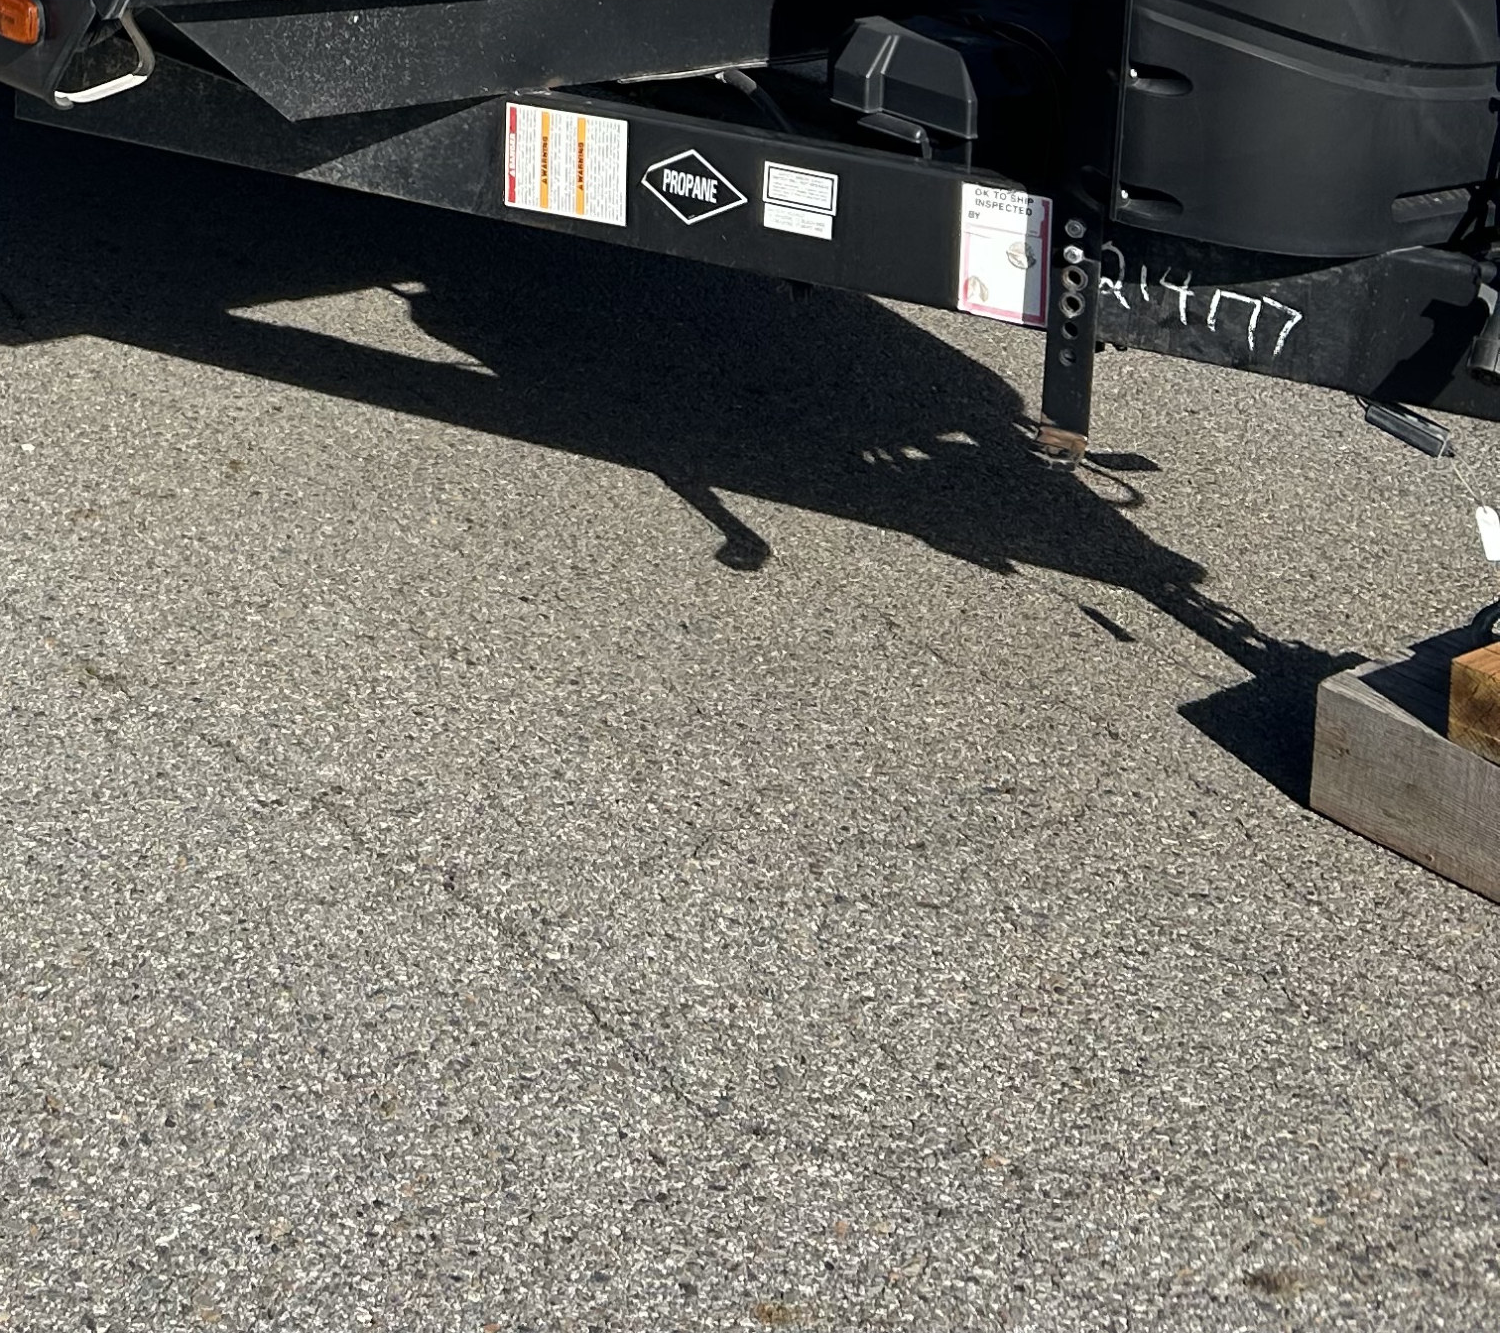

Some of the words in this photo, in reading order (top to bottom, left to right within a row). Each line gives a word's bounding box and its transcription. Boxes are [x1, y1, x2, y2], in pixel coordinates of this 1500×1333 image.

[541, 136, 549, 177] WARNING
[577, 142, 585, 183] WARNING
[662, 168, 718, 204] PROPANE
[974, 188, 990, 198] OK
[994, 190, 1007, 201] TO
[1010, 192, 1035, 205] SHIP
[967, 210, 981, 220] BY
[974, 198, 1033, 216] INSPECTED
